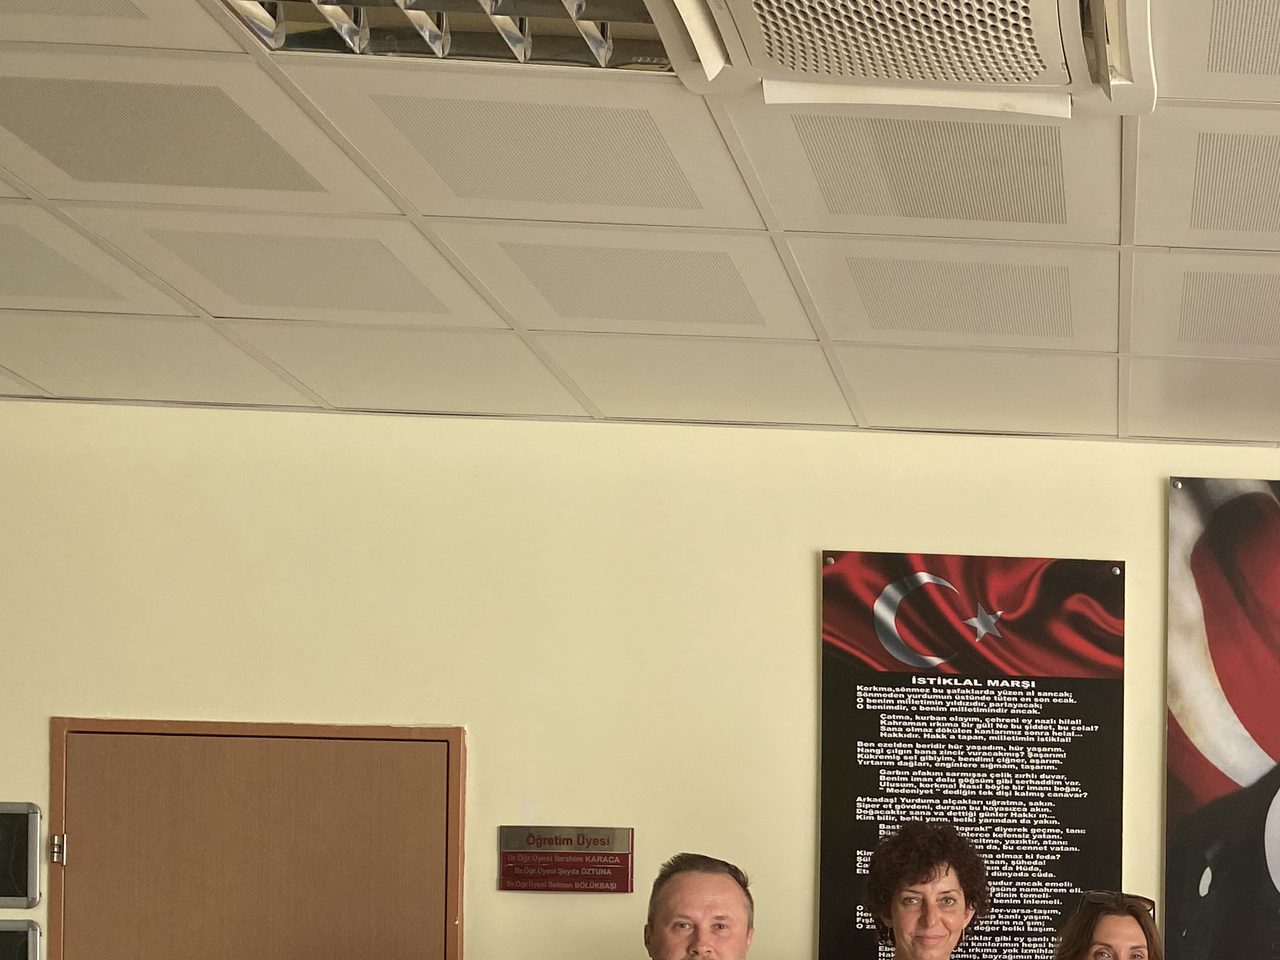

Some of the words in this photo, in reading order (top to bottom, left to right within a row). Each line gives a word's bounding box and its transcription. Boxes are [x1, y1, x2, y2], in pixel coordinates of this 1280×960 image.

[911, 676, 982, 686] İSTİKLAL
[987, 678, 1035, 689] MARŞI
[527, 833, 572, 848] Öğretim
[577, 833, 610, 848] Üyesi
[585, 856, 620, 864] KARACA
[581, 867, 612, 876] ÖZTUNA
